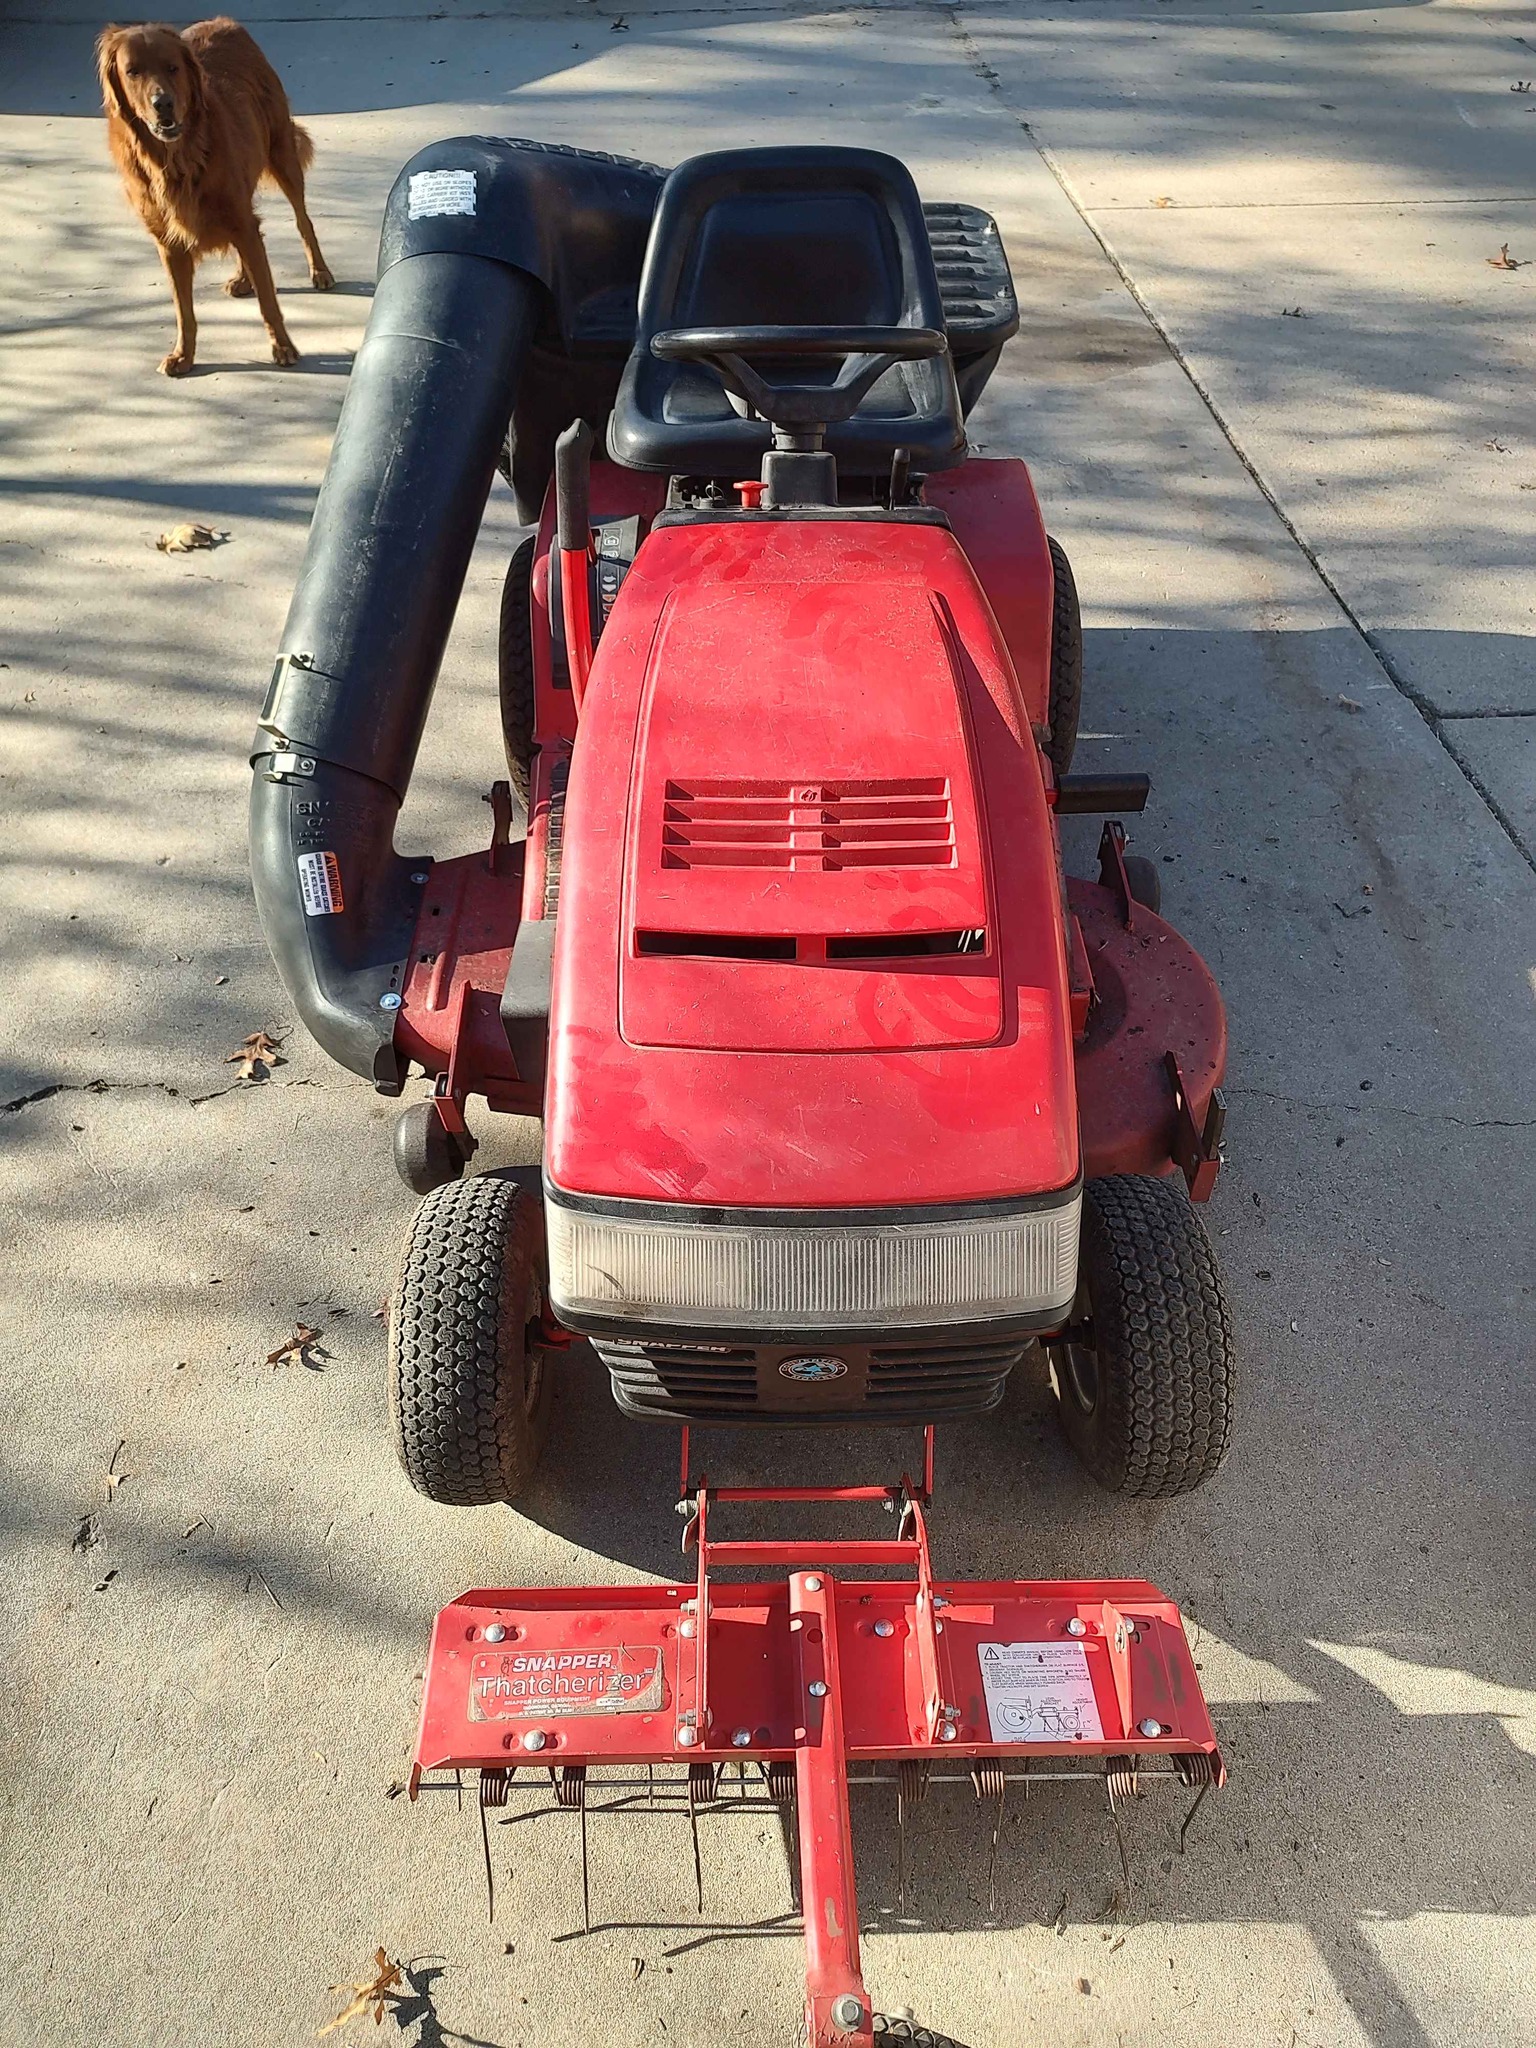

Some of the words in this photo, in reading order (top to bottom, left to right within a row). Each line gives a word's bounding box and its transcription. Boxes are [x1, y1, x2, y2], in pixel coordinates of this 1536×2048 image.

[326, 864, 343, 907] WARNING
[512, 1654, 613, 1673] SNAPPER
[477, 1671, 647, 1698] Thatcherizer
